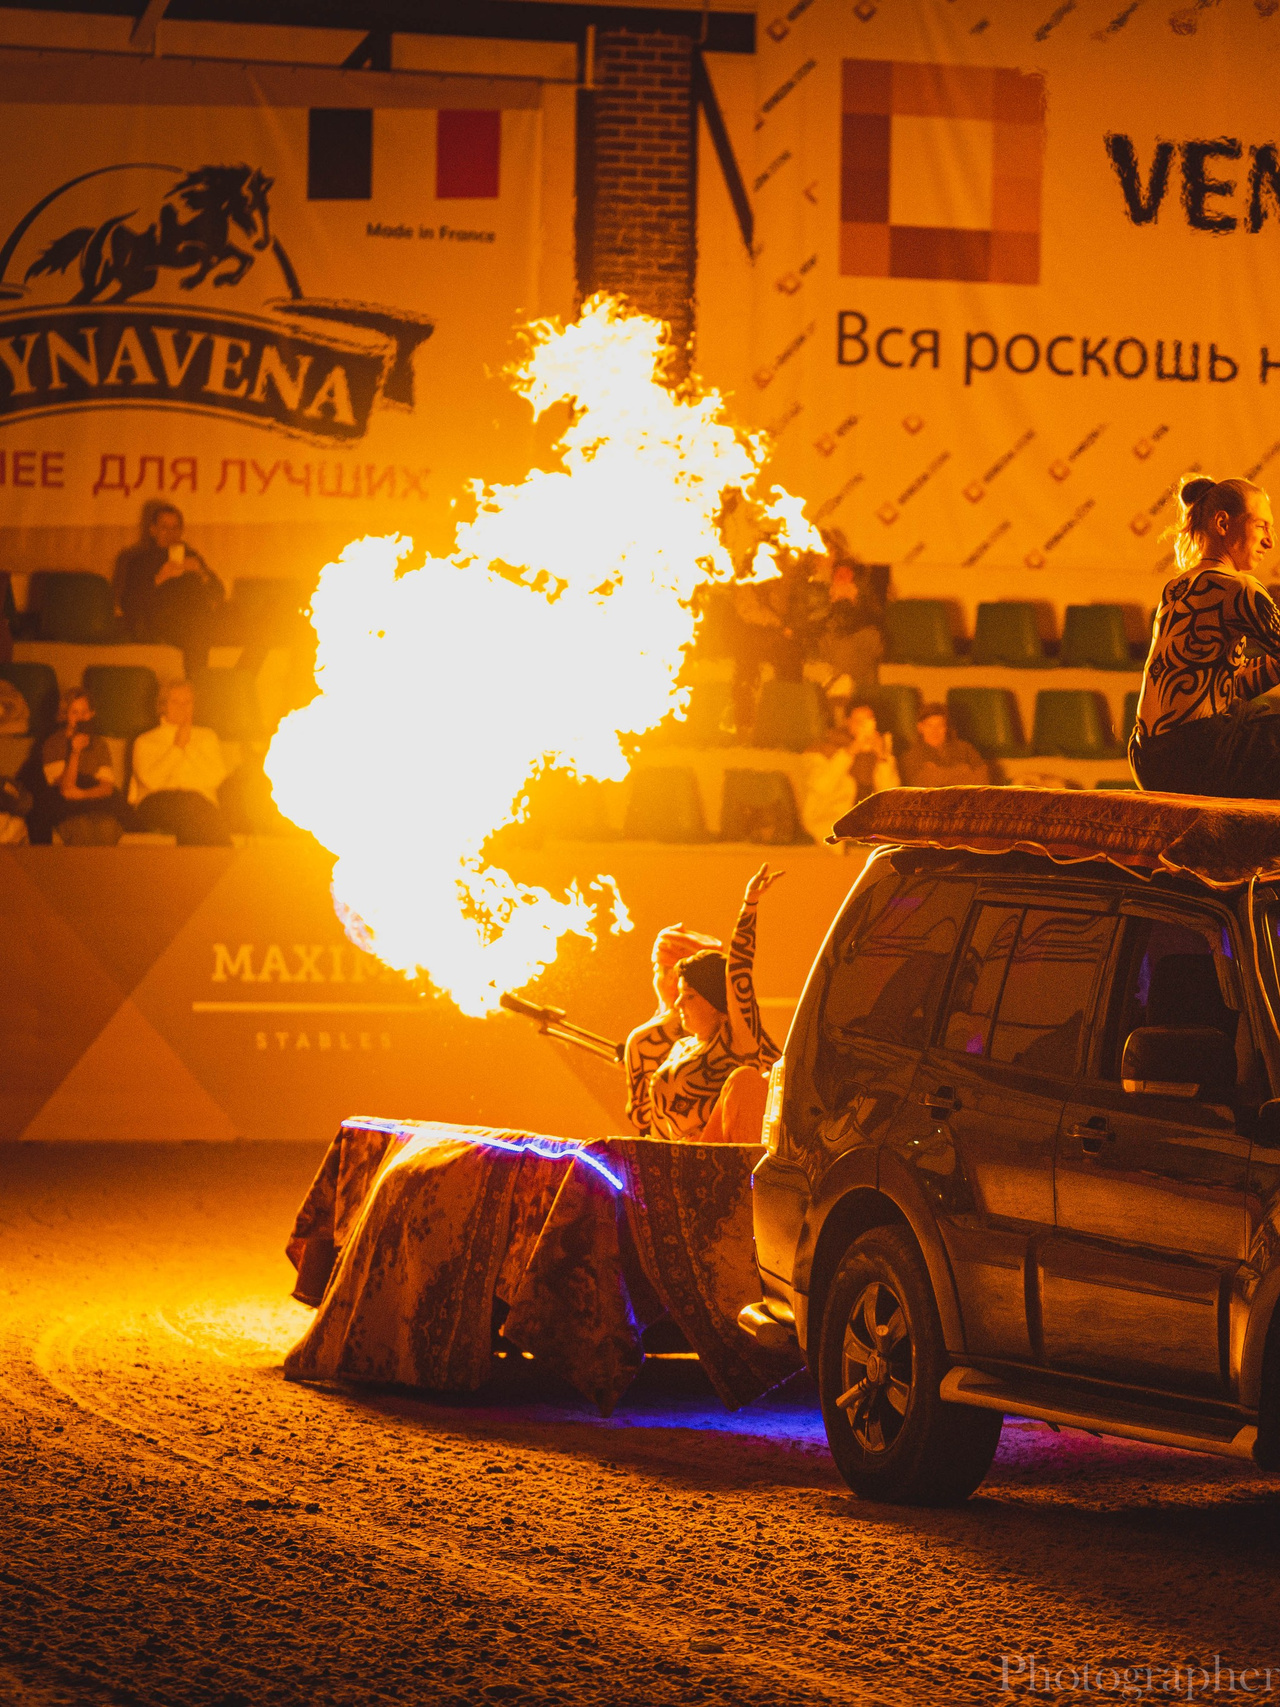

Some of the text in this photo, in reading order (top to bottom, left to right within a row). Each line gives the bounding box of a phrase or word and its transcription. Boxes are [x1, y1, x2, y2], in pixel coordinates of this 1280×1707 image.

[366, 222, 496, 243] Made in France
[836, 310, 940, 369] Вся
[964, 321, 1239, 388] роскошь
[0, 450, 430, 499] ЕЕ ДЛЯ ЛУЧШИХ
[212, 943, 396, 983] MAXIM
[256, 1031, 393, 1050] STABLES
